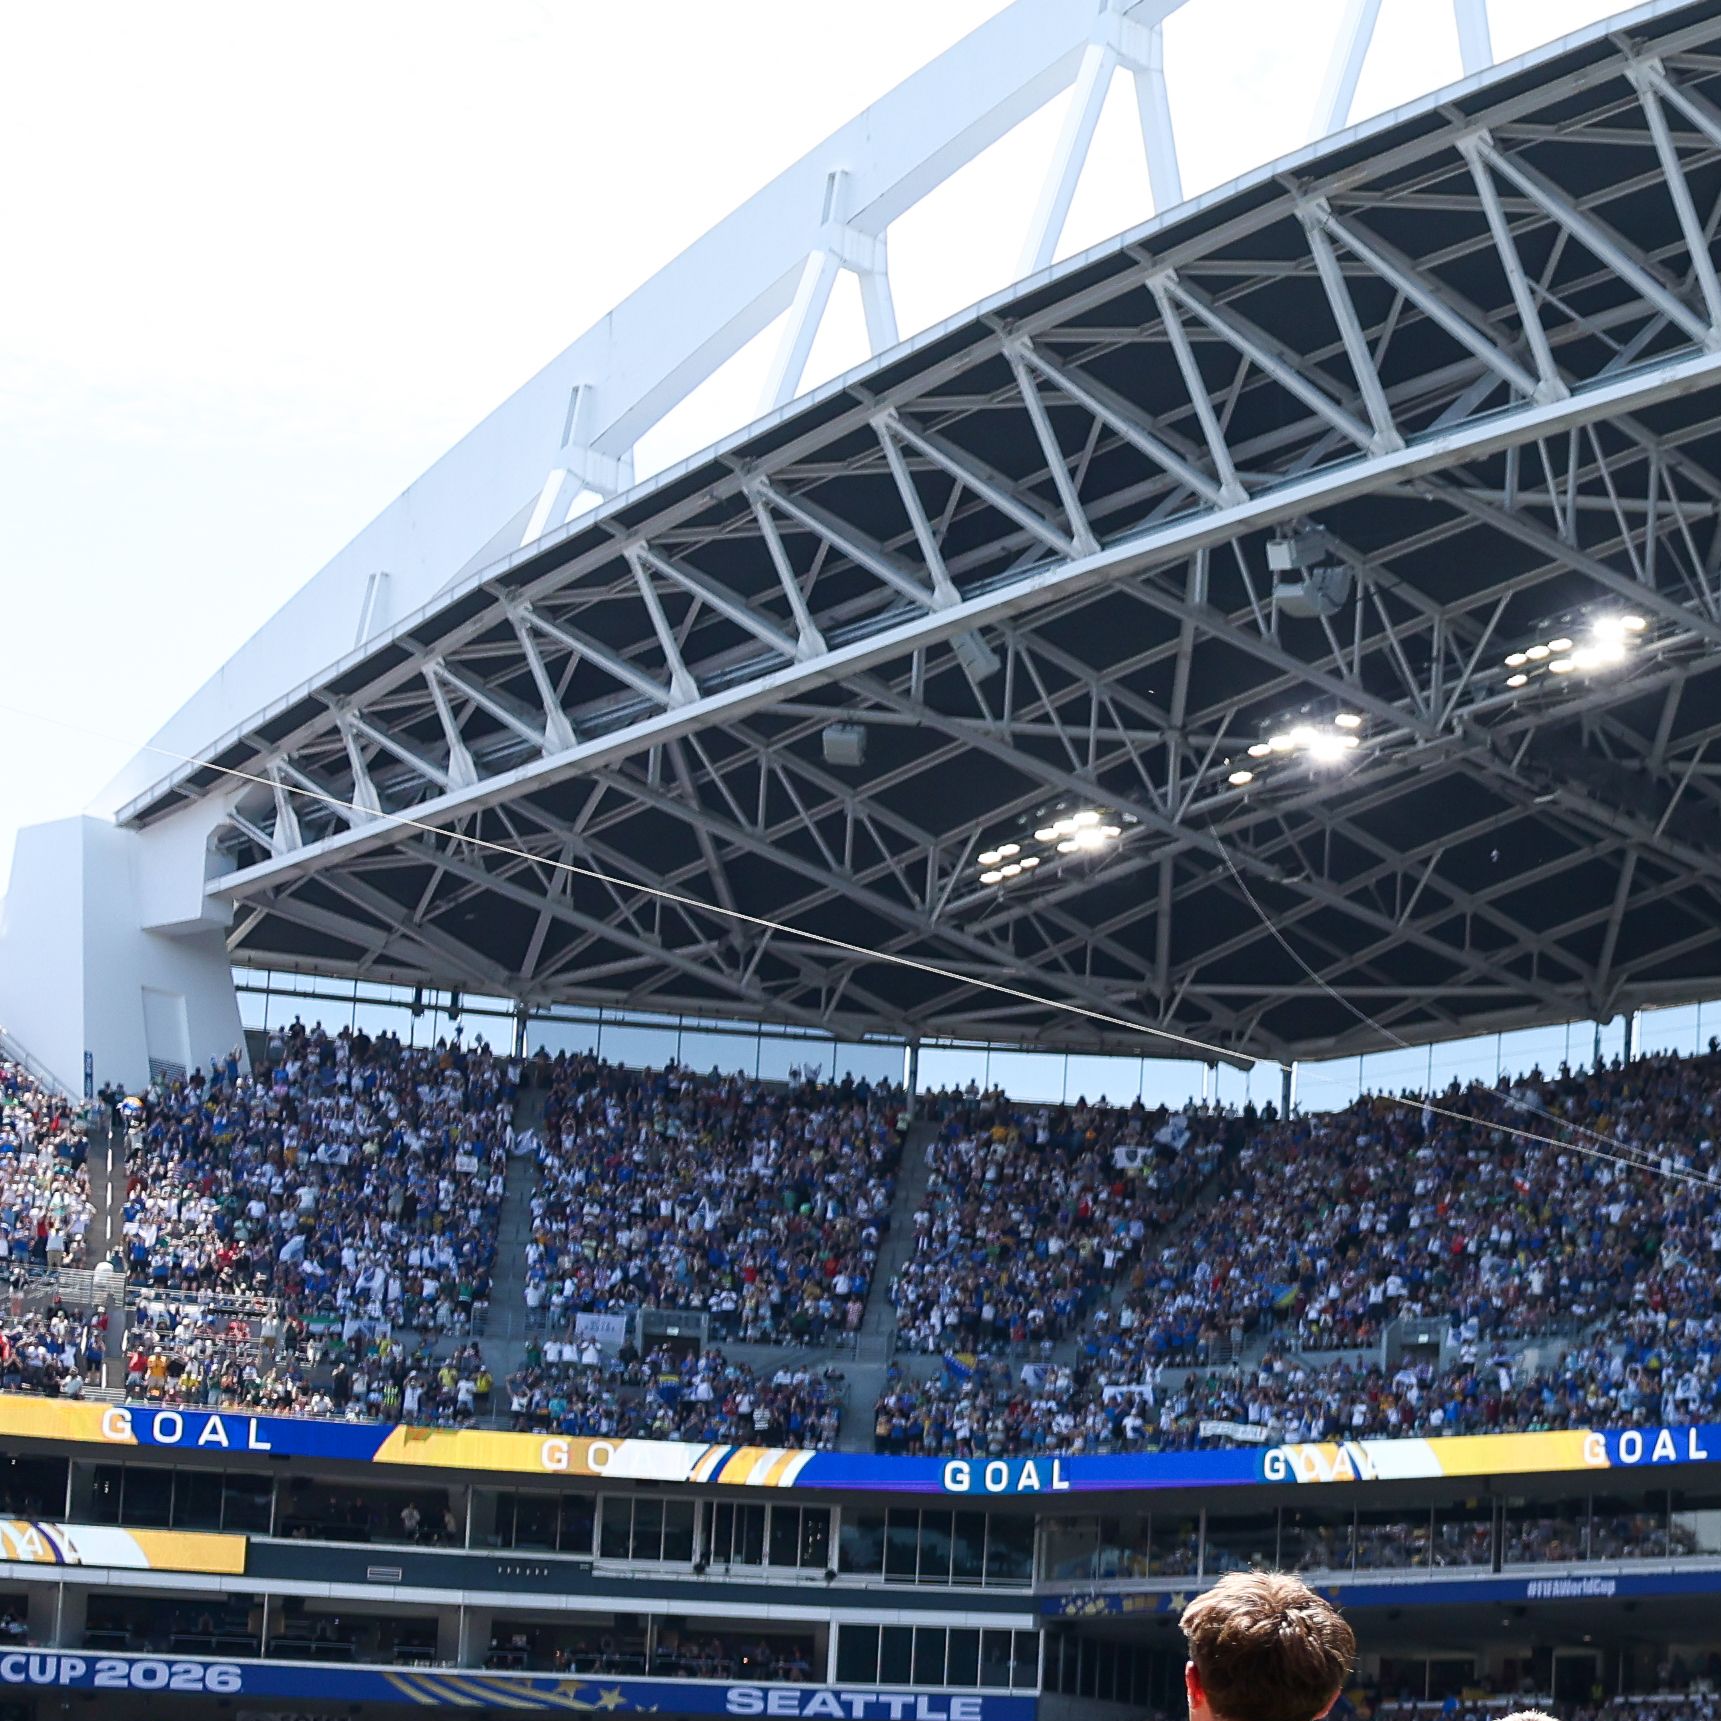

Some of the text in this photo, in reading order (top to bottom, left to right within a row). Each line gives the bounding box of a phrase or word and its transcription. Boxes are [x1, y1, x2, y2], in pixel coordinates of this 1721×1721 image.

[101, 1408, 272, 1451] GOAL
[1582, 1427, 1708, 1465] GOAL
[943, 1457, 1071, 1493] GOAL
[1527, 1577, 1617, 1600] #FIFAWorldCup
[0, 1654, 243, 1694] CUP 2026
